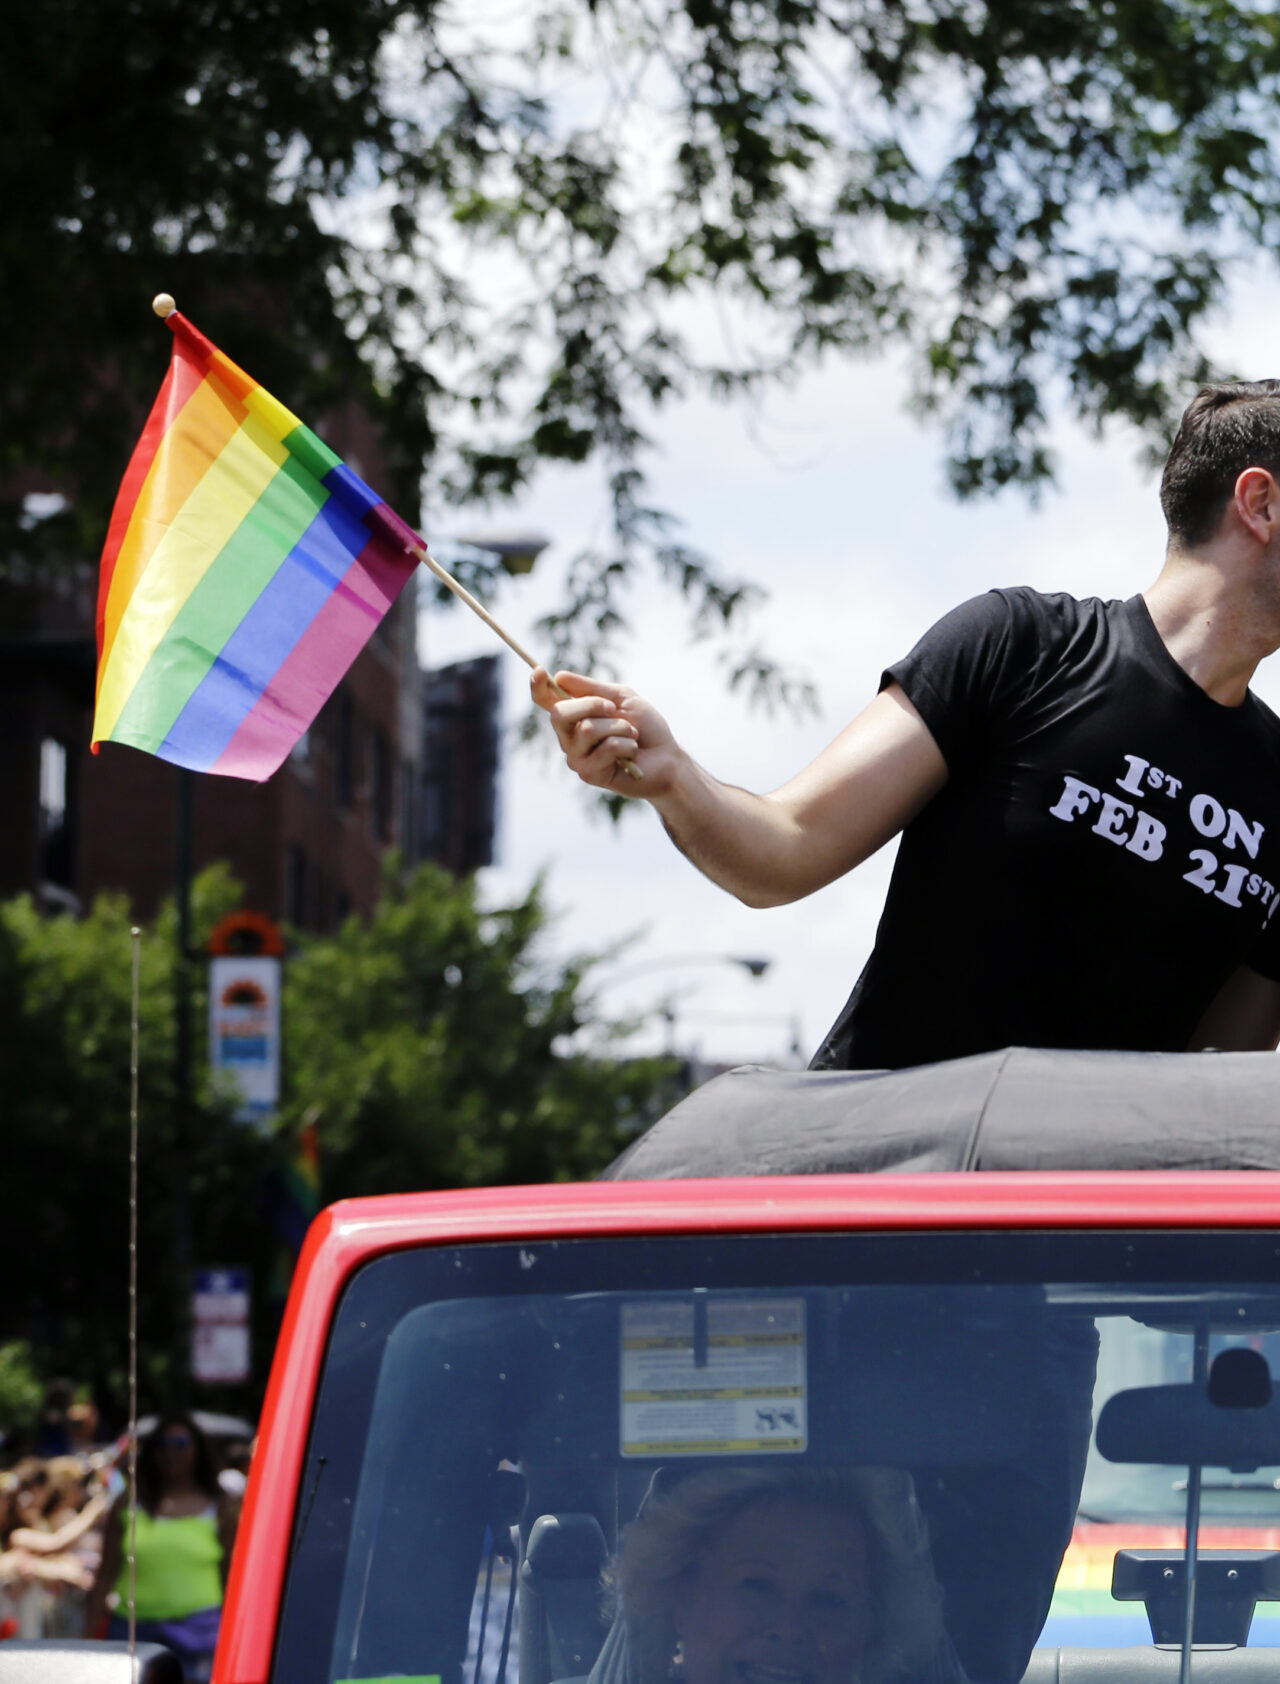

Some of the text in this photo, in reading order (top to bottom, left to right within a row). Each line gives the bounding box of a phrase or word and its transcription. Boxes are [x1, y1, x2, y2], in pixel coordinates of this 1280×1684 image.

[1049, 776, 1280, 930] FEB 21ST!
[1115, 754, 1265, 859] 1ST ON
